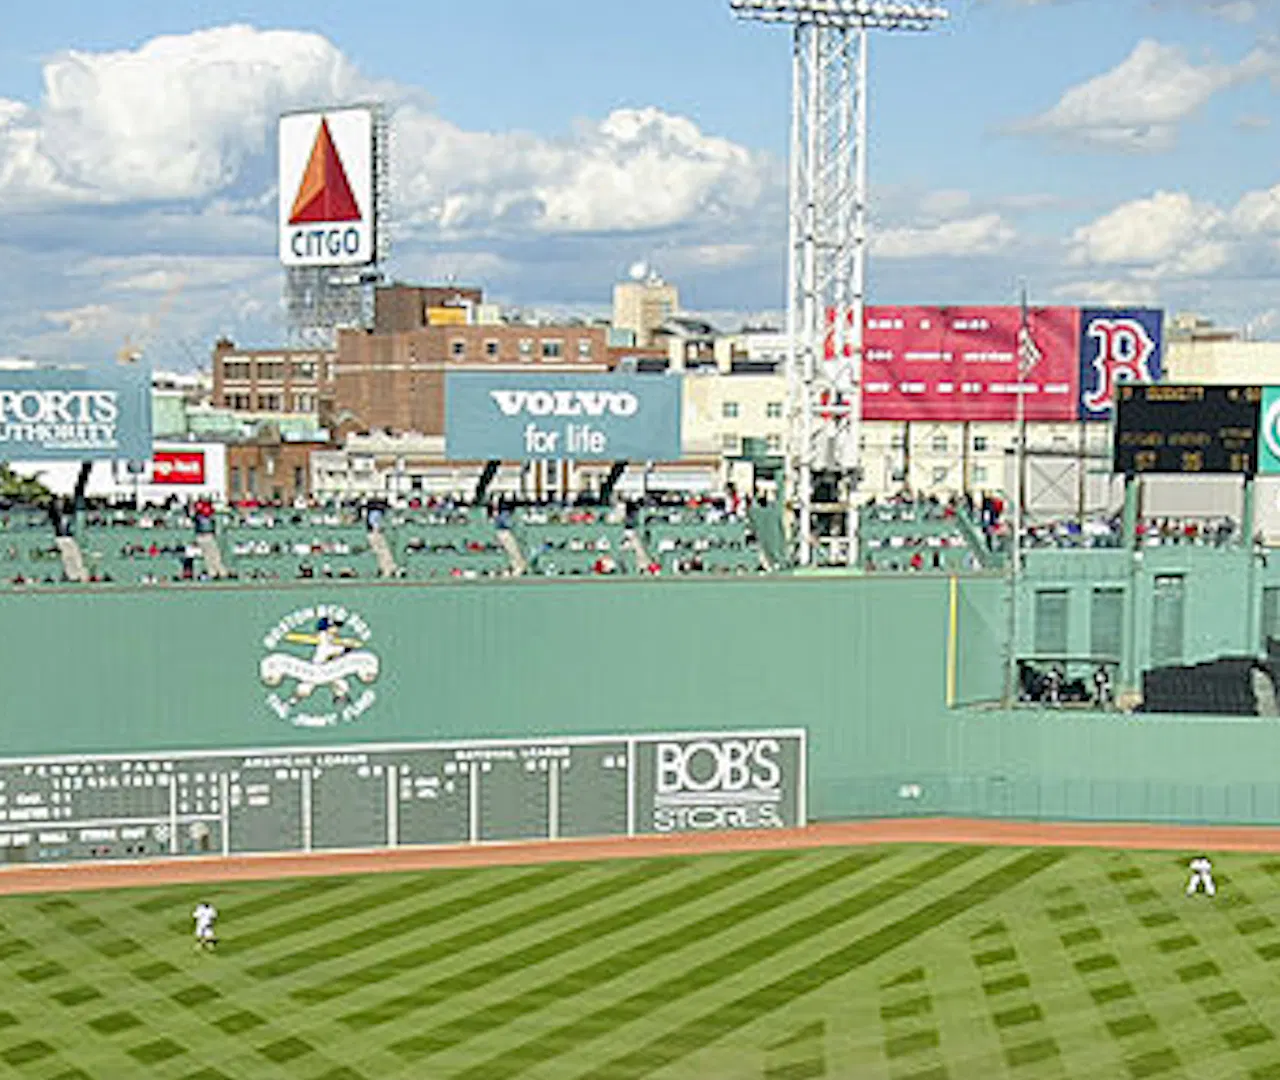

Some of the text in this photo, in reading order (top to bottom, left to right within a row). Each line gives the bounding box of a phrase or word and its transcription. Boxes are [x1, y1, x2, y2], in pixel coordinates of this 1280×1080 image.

[291, 227, 359, 257] CITGO
[489, 389, 639, 417] VOLVO
[523, 422, 607, 453] for life
[243, 753, 368, 768] AMERICAN LEAGUE
[657, 738, 781, 792] BOB'S
[653, 803, 784, 832] STORES
